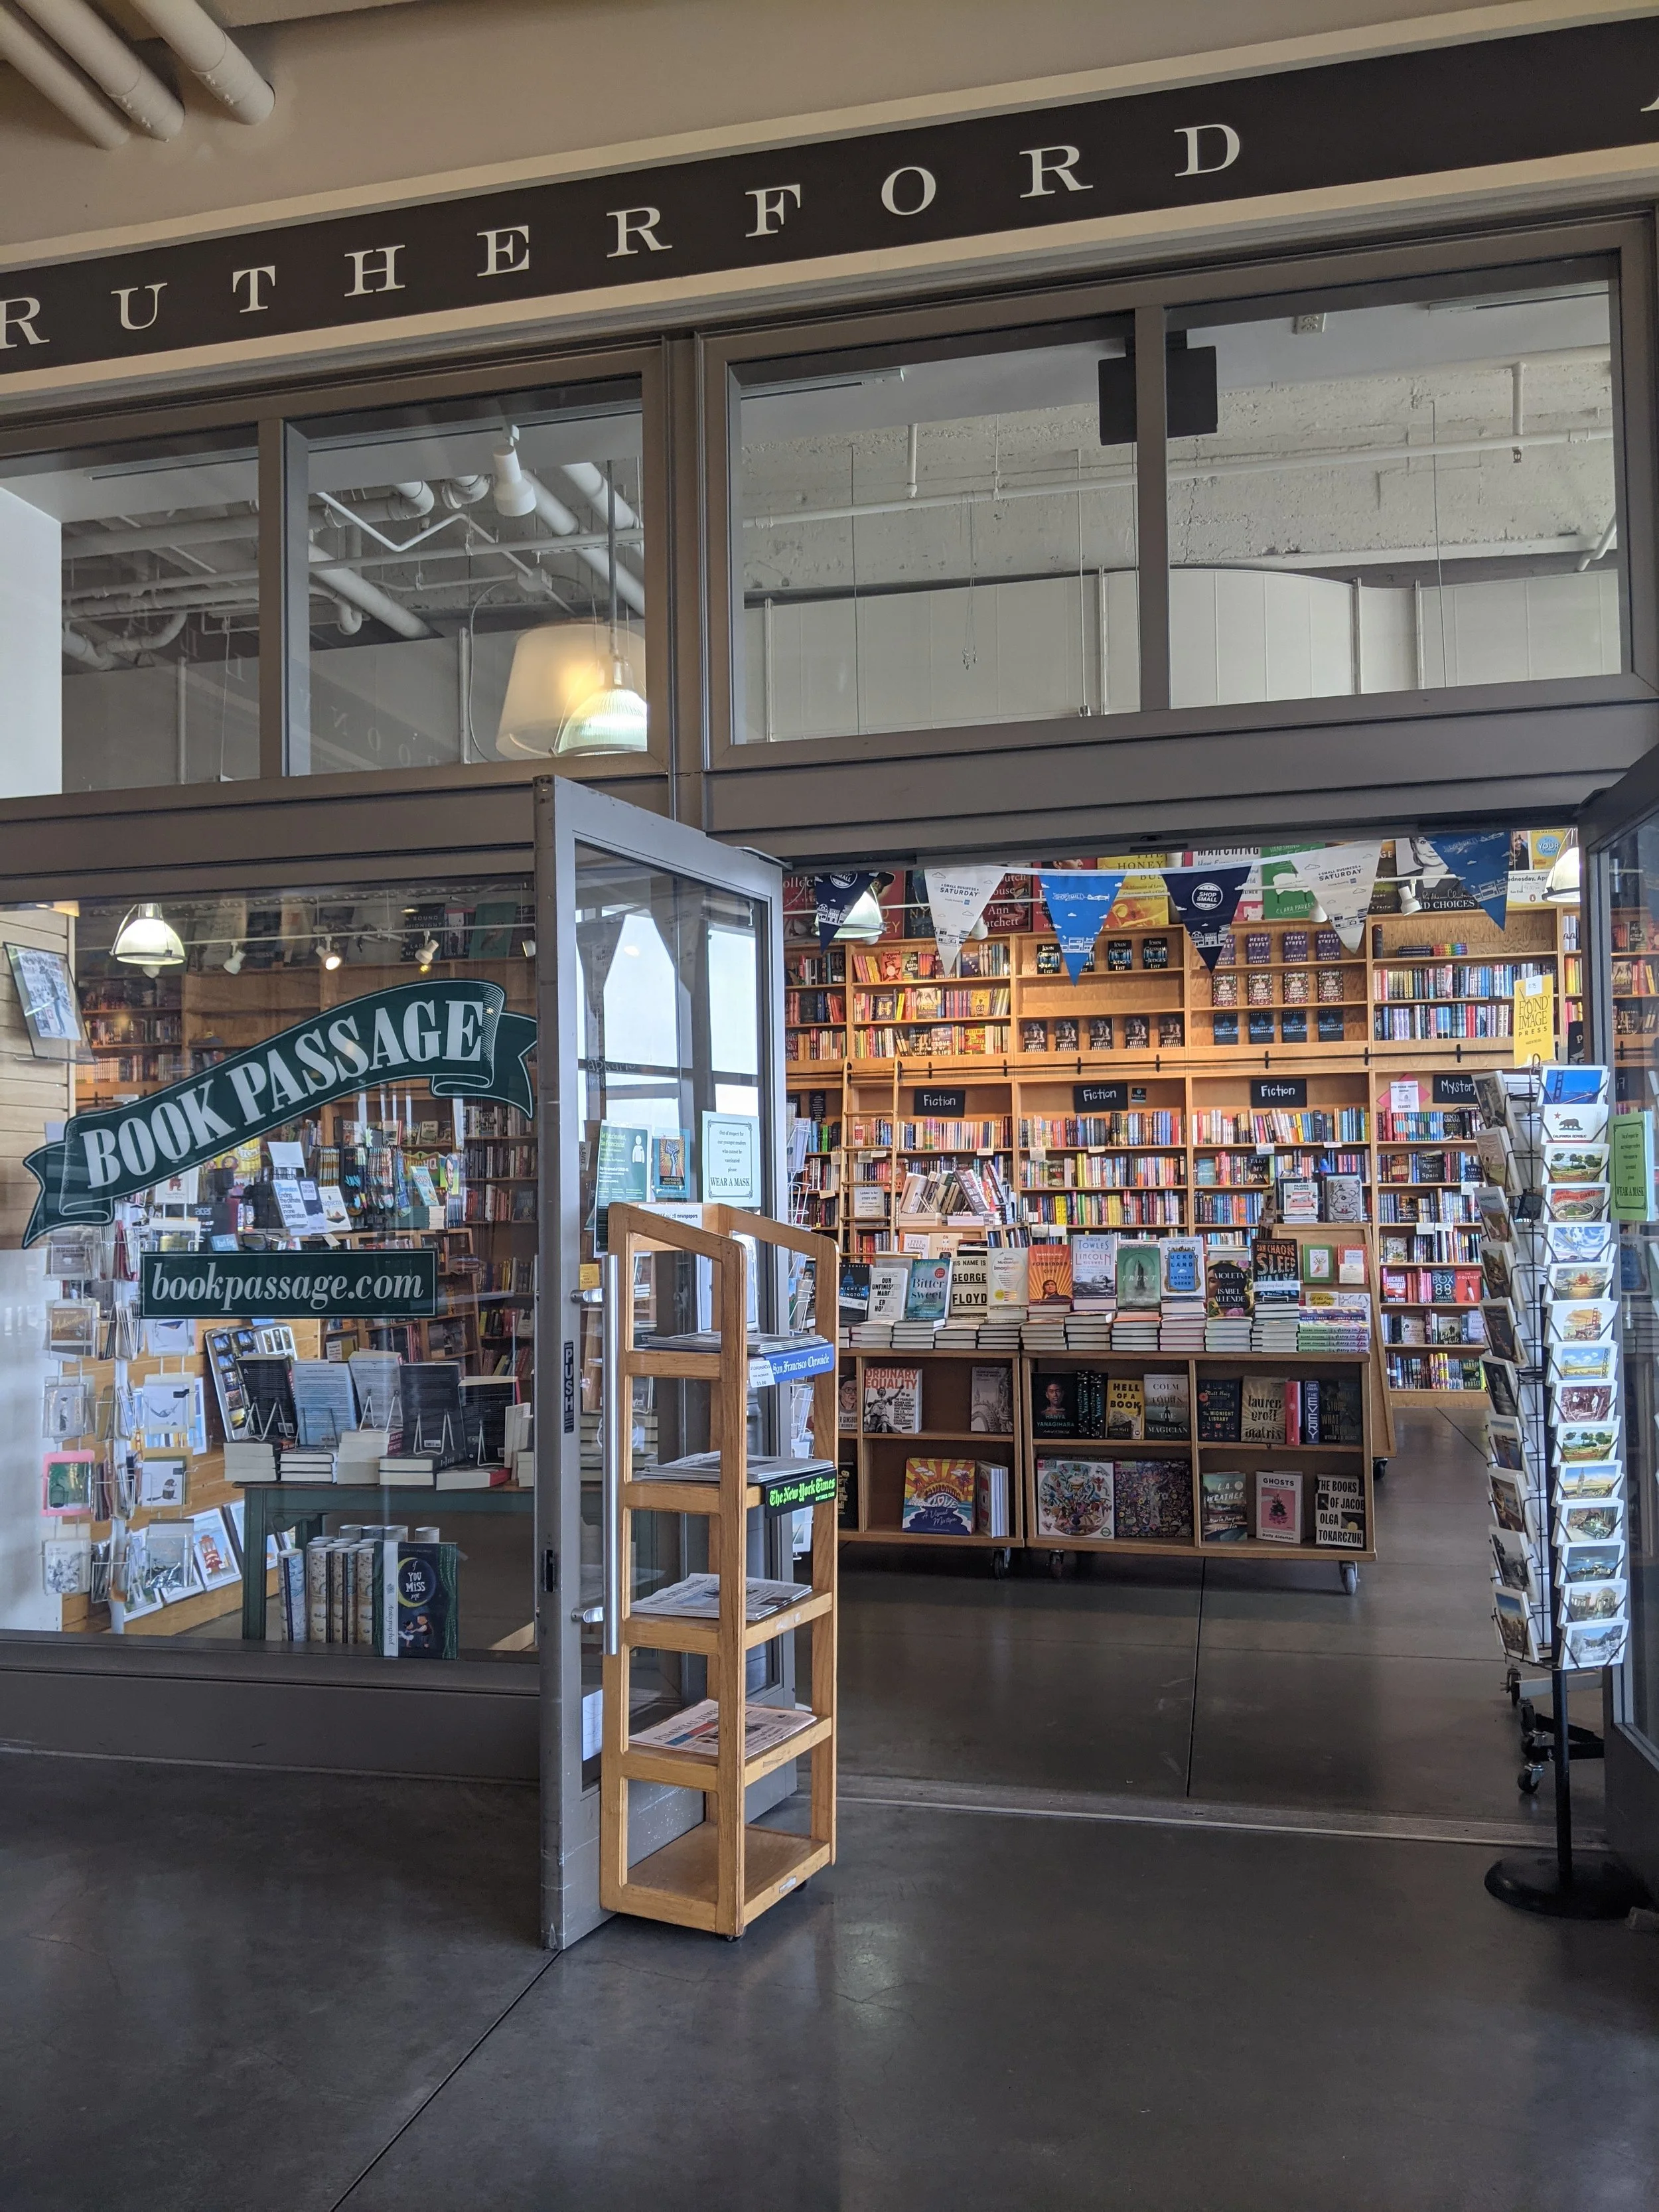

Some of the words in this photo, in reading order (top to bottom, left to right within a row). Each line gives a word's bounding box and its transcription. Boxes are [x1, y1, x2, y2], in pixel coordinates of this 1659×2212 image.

[1118, 861, 1163, 869] HONEY
[1319, 868, 1362, 881] SATURDAY
[940, 887, 978, 897] SATURDAY
[988, 905, 1009, 915] Ann
[1433, 900, 1475, 909] CHOICES
[1518, 1011, 1548, 1030] IMAGE
[1518, 1026, 1548, 1037] PRESS
[1261, 1084, 1295, 1097] Fiction
[1441, 1079, 1477, 1096] Mystery
[80, 1080, 237, 1189] BOOK
[226, 1000, 483, 1125] PASSAGE
[924, 1094, 956, 1106] Fiction
[1083, 1088, 1116, 1102] Fiction
[710, 1177, 727, 1186] WEAR
[729, 1177, 733, 1186] A
[734, 1178, 750, 1187] MASK
[1580, 1191, 1595, 1199] GIANTS
[322, 1200, 342, 1209] Sapiens
[1078, 1240, 1109, 1250] TOWLES
[1076, 1253, 1112, 1266] LINCOLN
[1256, 1253, 1296, 1275] SLEEP
[912, 1278, 945, 1288] Bitter-
[952, 1273, 986, 1282] GEORGE
[1432, 1276, 1453, 1284] BOX
[152, 1262, 423, 1310] bookpassage.com
[1435, 1284, 1452, 1295] 88
[911, 1291, 942, 1299] sweet
[953, 1293, 987, 1303] FLOYD
[773, 1364, 782, 1374] San
[783, 1359, 806, 1374] Francisco
[807, 1353, 830, 1368] Chronicle
[565, 1348, 573, 1410] PUSH
[866, 1368, 918, 1380] ORDINARY
[865, 1378, 918, 1390] EQUALITY
[1112, 1383, 1140, 1392] HELL
[1110, 1400, 1141, 1409] BOOK
[1248, 1395, 1282, 1408] lauren
[1251, 1409, 1277, 1422] groff
[1307, 1397, 1318, 1439] EVERY
[1245, 1426, 1281, 1439] matrix
[1263, 1478, 1294, 1487] GHOSTS
[1318, 1480, 1331, 1491] THE
[1332, 1481, 1357, 1493] BOOKS
[769, 1488, 784, 1507] The
[783, 1487, 799, 1504] New
[798, 1481, 816, 1503] York
[815, 1476, 835, 1495] Times
[815, 1492, 835, 1502] NYTIMES.COM
[1206, 1492, 1244, 1502] WEATHER
[928, 1495, 959, 1509] LOVE
[1330, 1497, 1339, 1508] OF
[1340, 1498, 1364, 1511] JACOB
[1320, 1512, 1339, 1525] OLGA
[1319, 1530, 1362, 1544] TOKARCZUK
[408, 1572, 421, 1582] YOU
[653, 1717, 695, 1741] FINANCIAL
